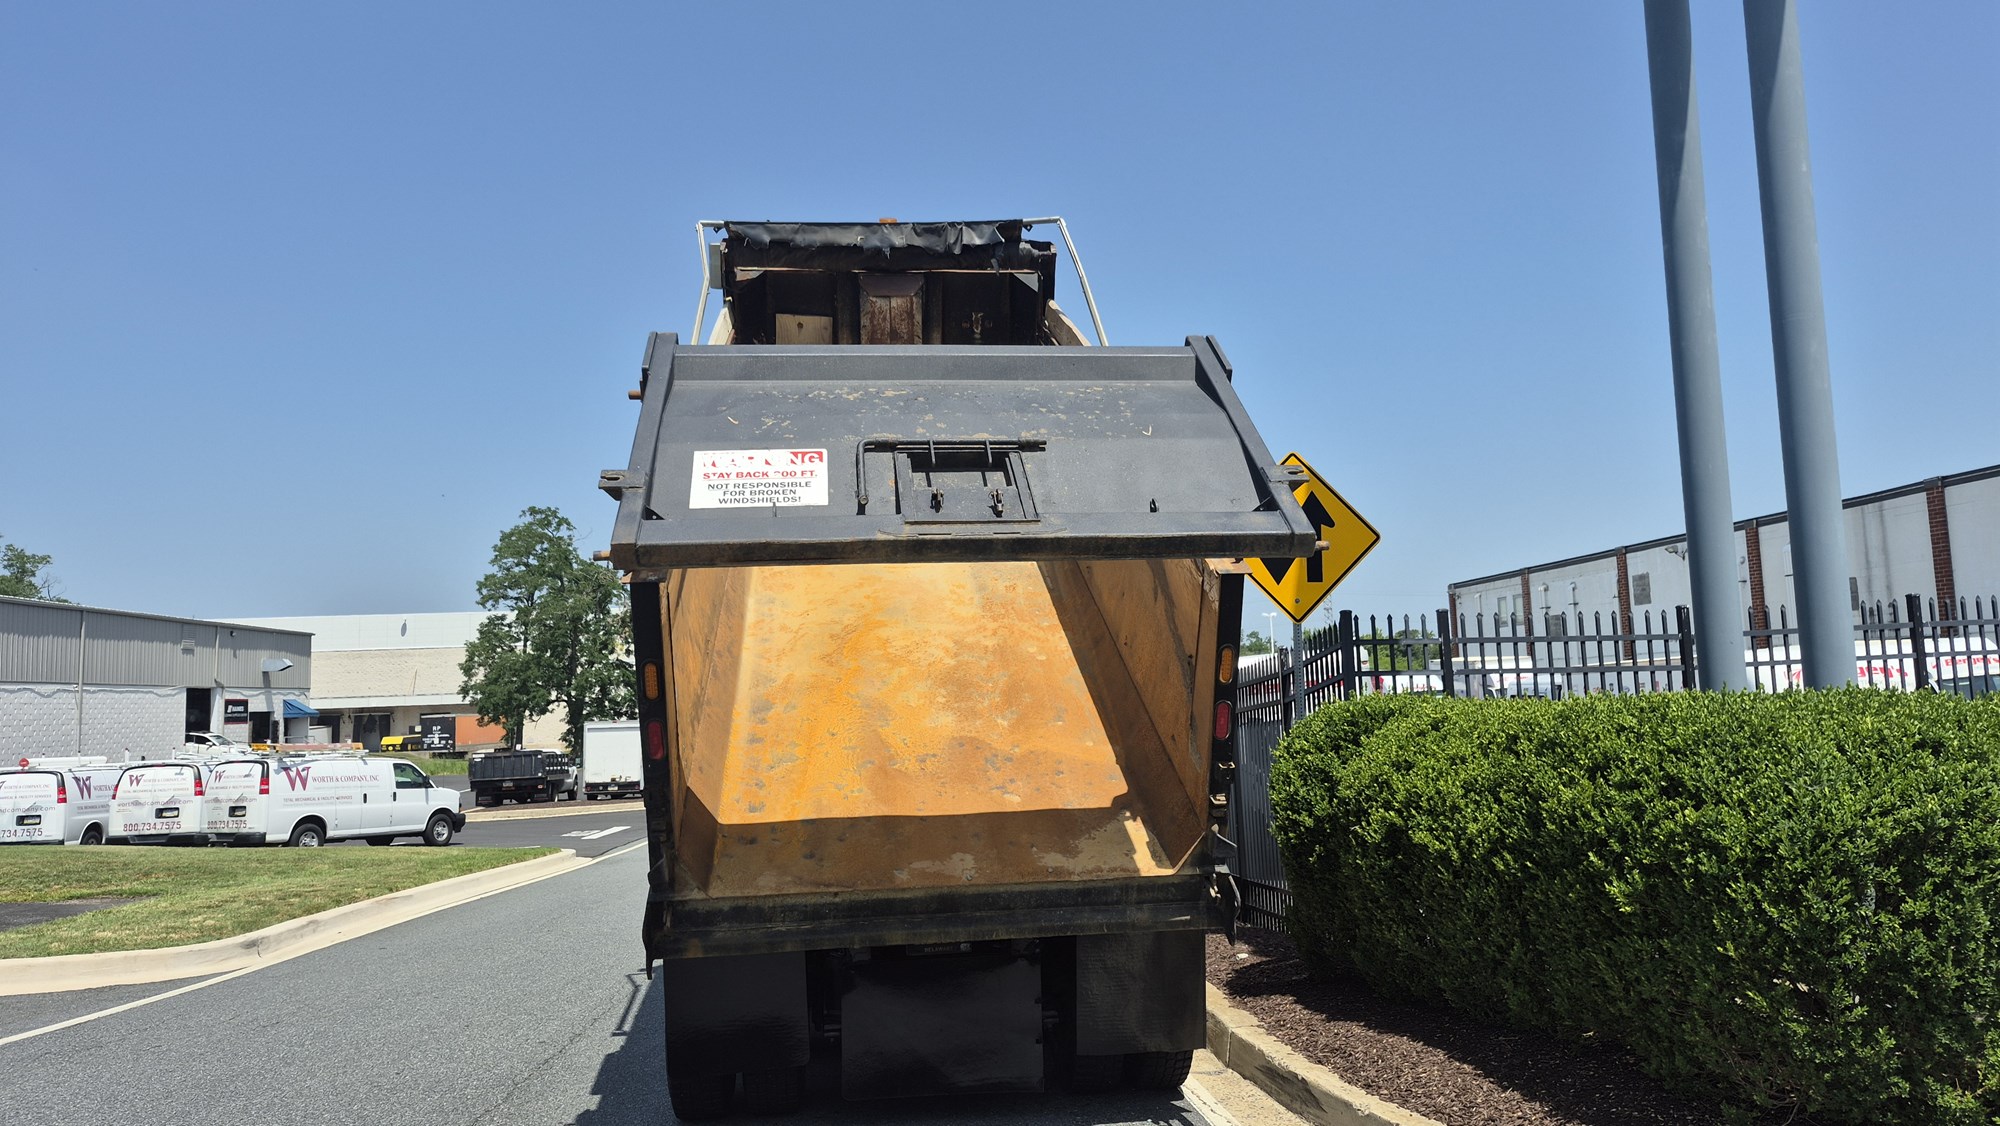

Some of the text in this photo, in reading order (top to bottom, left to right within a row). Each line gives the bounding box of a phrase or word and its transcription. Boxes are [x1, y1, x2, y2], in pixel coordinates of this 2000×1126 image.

[703, 472, 732, 480] STAY
[736, 471, 769, 479] BACK
[801, 470, 818, 478] FT.
[733, 481, 811, 490] RESPONSIBLE
[749, 489, 797, 497] BROKEN
[718, 496, 801, 505] WINDSHIELDS!
[312, 775, 334, 784] WORTH
[335, 775, 340, 783] &
[340, 774, 368, 783] COMPANY,
[123, 821, 181, 832] 800.734.7575
